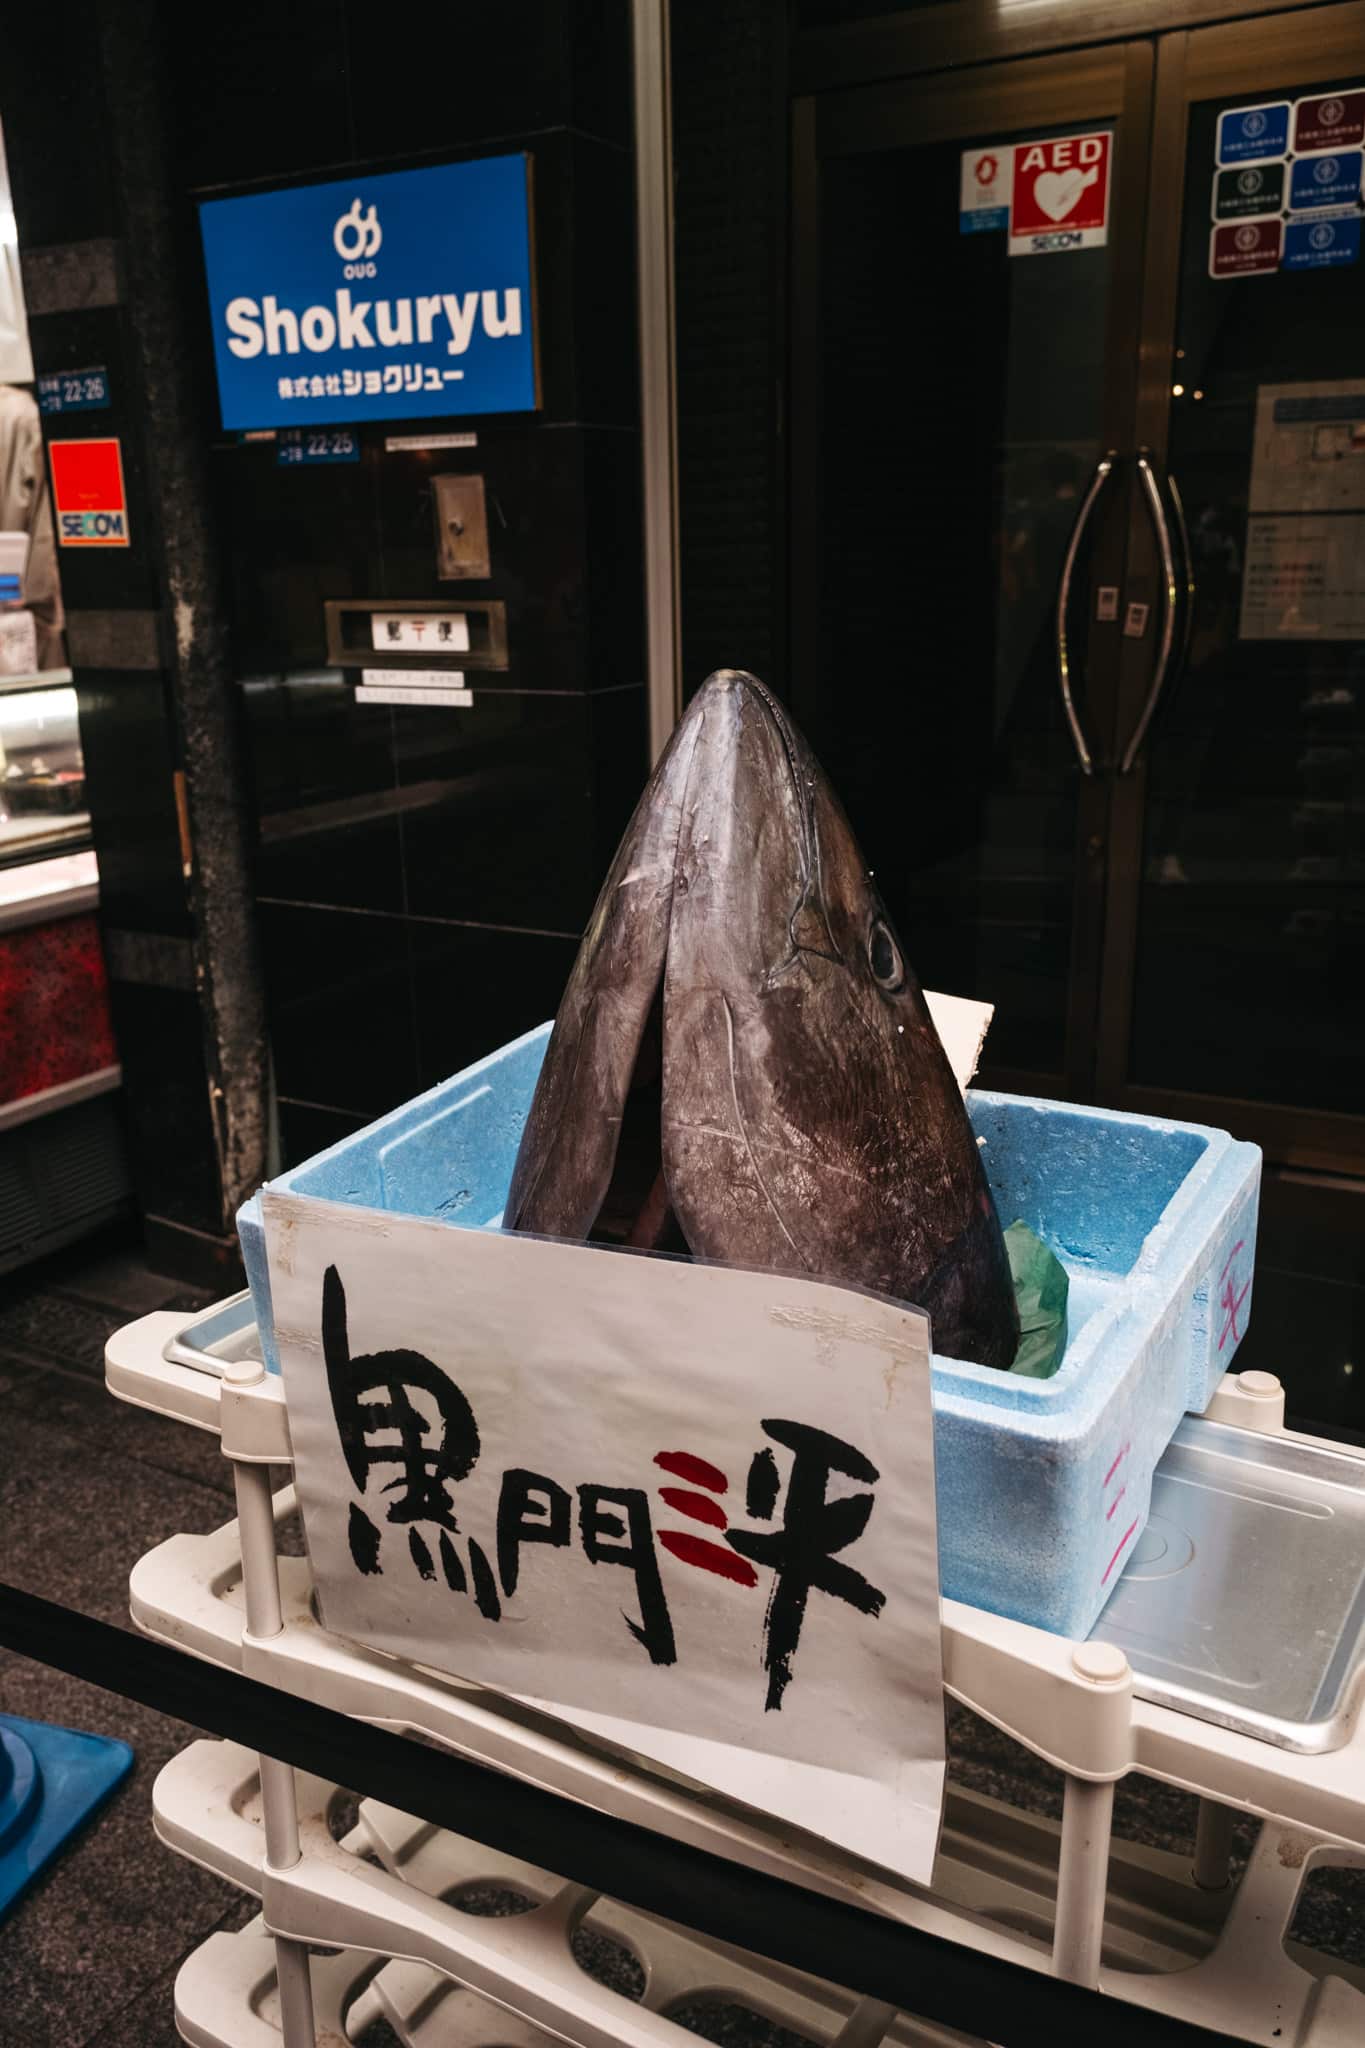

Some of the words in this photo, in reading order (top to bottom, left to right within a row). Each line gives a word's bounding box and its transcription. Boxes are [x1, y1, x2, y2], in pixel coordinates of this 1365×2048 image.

[1020, 138, 1103, 172] AED
[1031, 232, 1083, 251] SECOM
[343, 262, 377, 280] OUG
[225, 288, 522, 359] Shokuryu
[277, 363, 464, 399] 株式会社ショクリュー
[61, 512, 124, 537] SECOM
